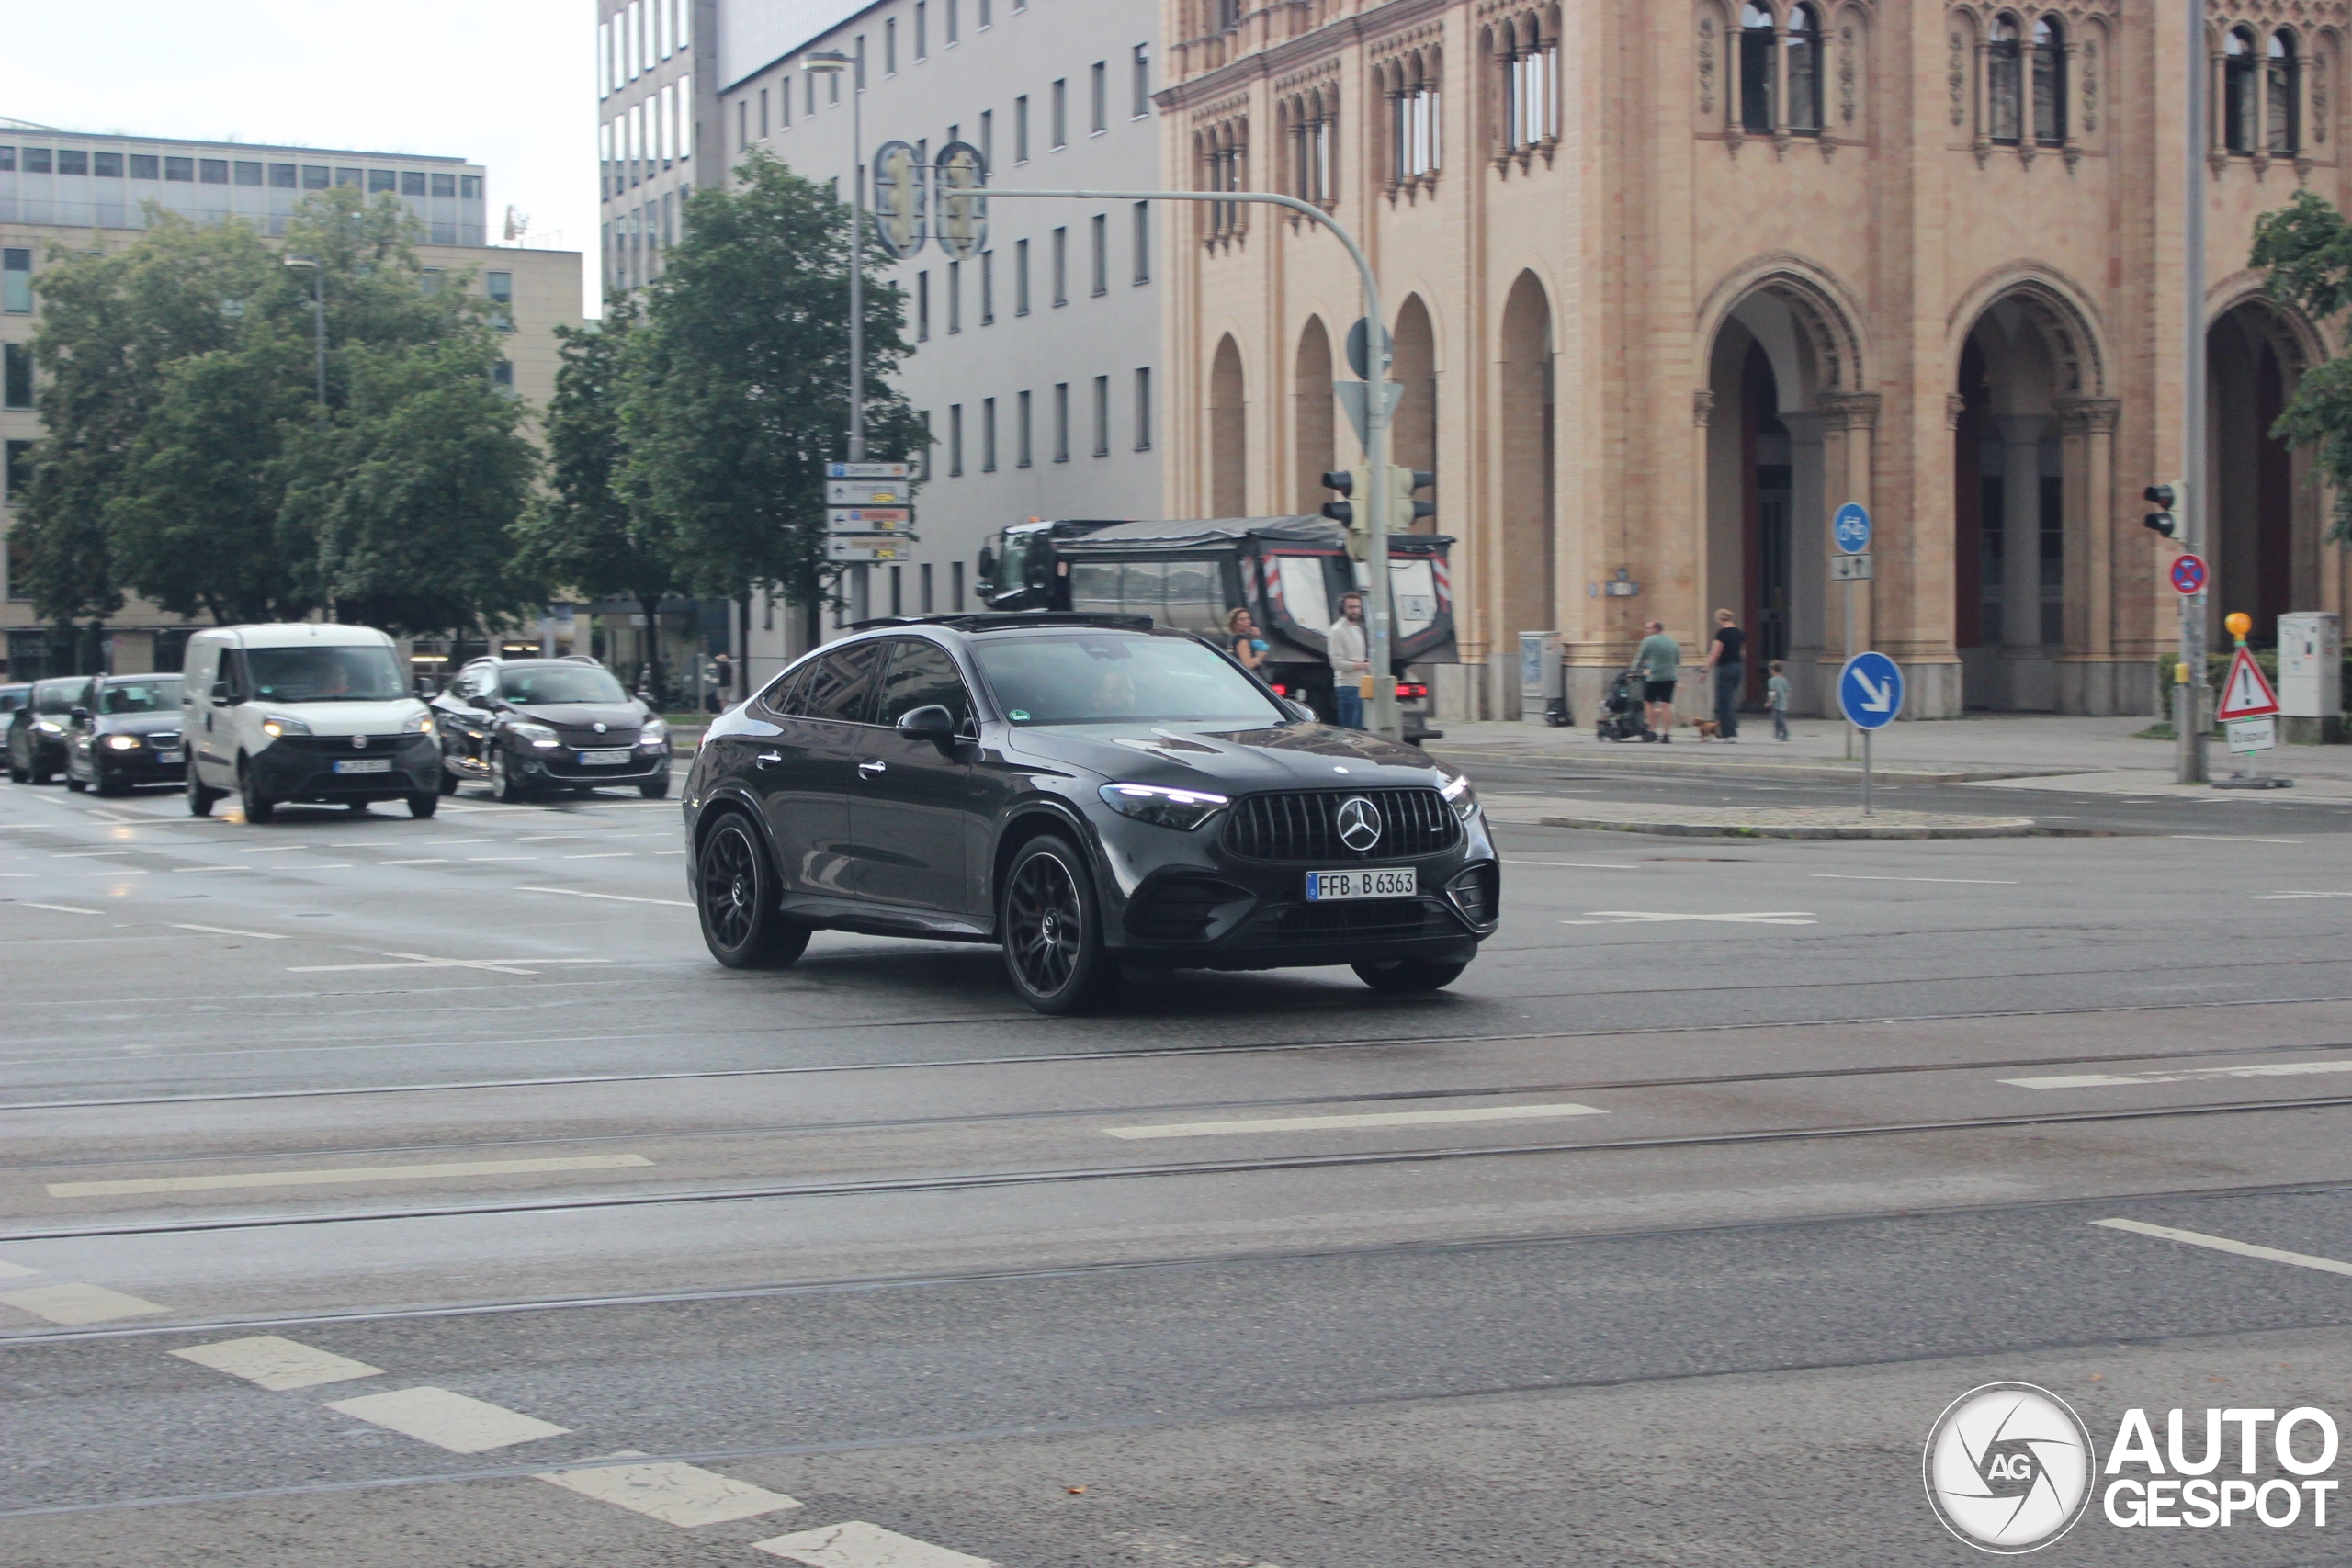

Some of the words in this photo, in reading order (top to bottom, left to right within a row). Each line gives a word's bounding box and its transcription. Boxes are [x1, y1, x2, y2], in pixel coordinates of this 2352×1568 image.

[1319, 875, 1350, 896] FFB
[1363, 874, 1373, 894] B
[1376, 874, 1413, 893] 6363
